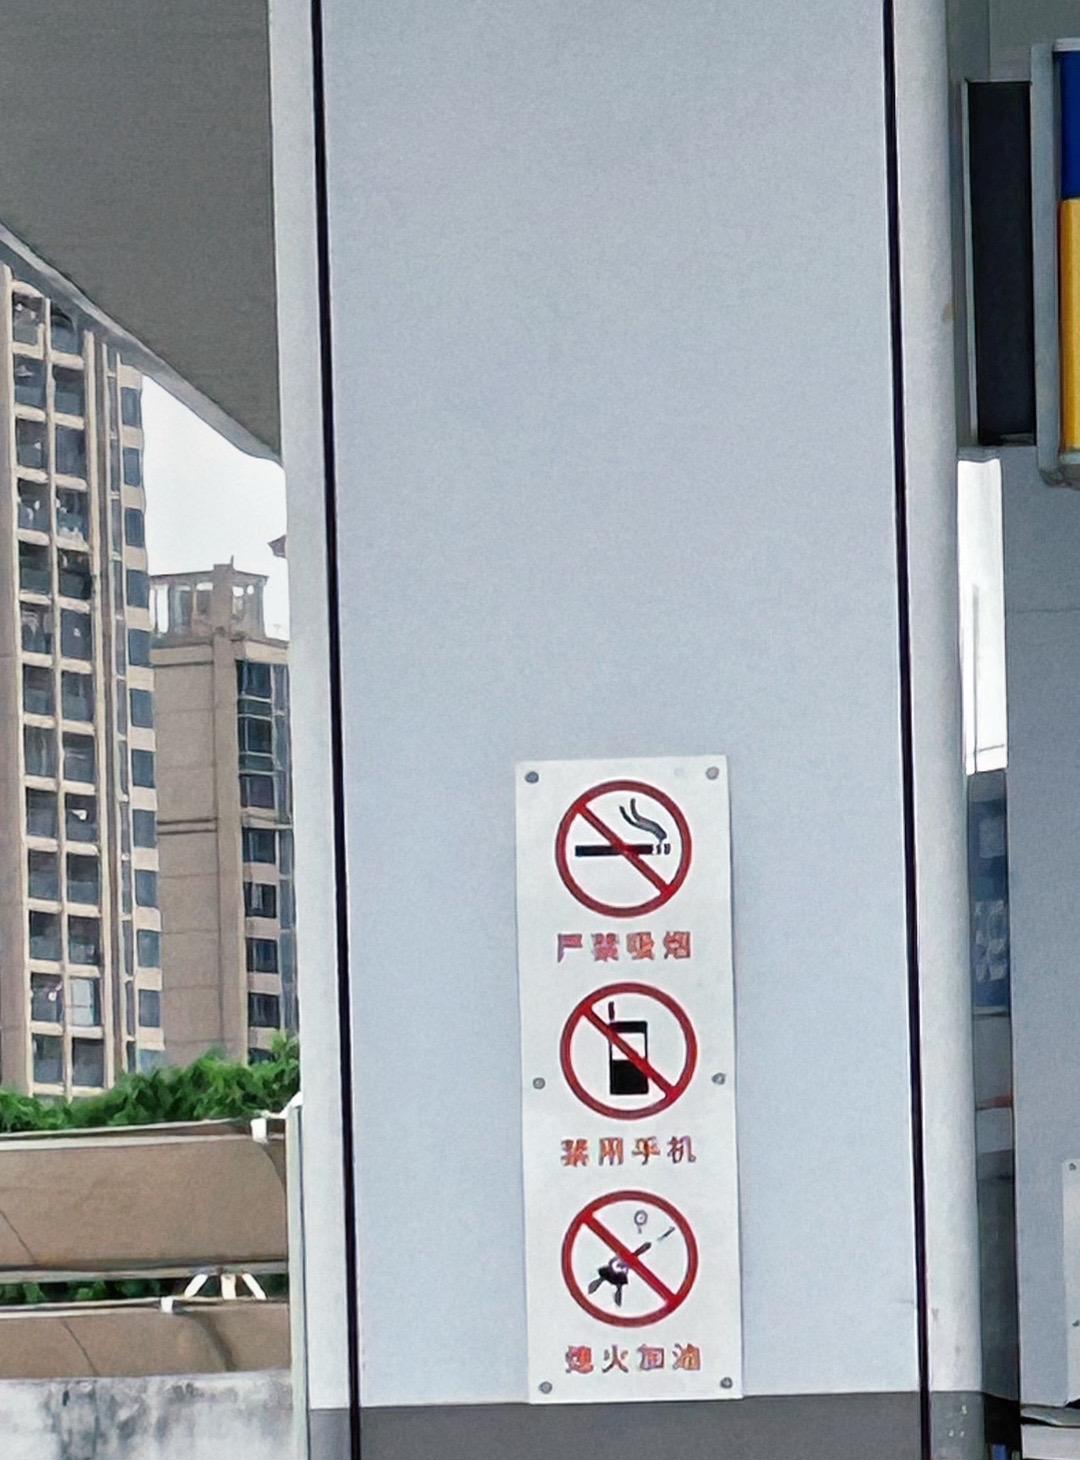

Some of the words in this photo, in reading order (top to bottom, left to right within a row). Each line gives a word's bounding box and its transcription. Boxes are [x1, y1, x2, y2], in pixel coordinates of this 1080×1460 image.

[557, 930, 692, 963] 严禁吸烟
[560, 1135, 697, 1168] 禁用手机
[564, 1343, 702, 1375] 熄火加油
